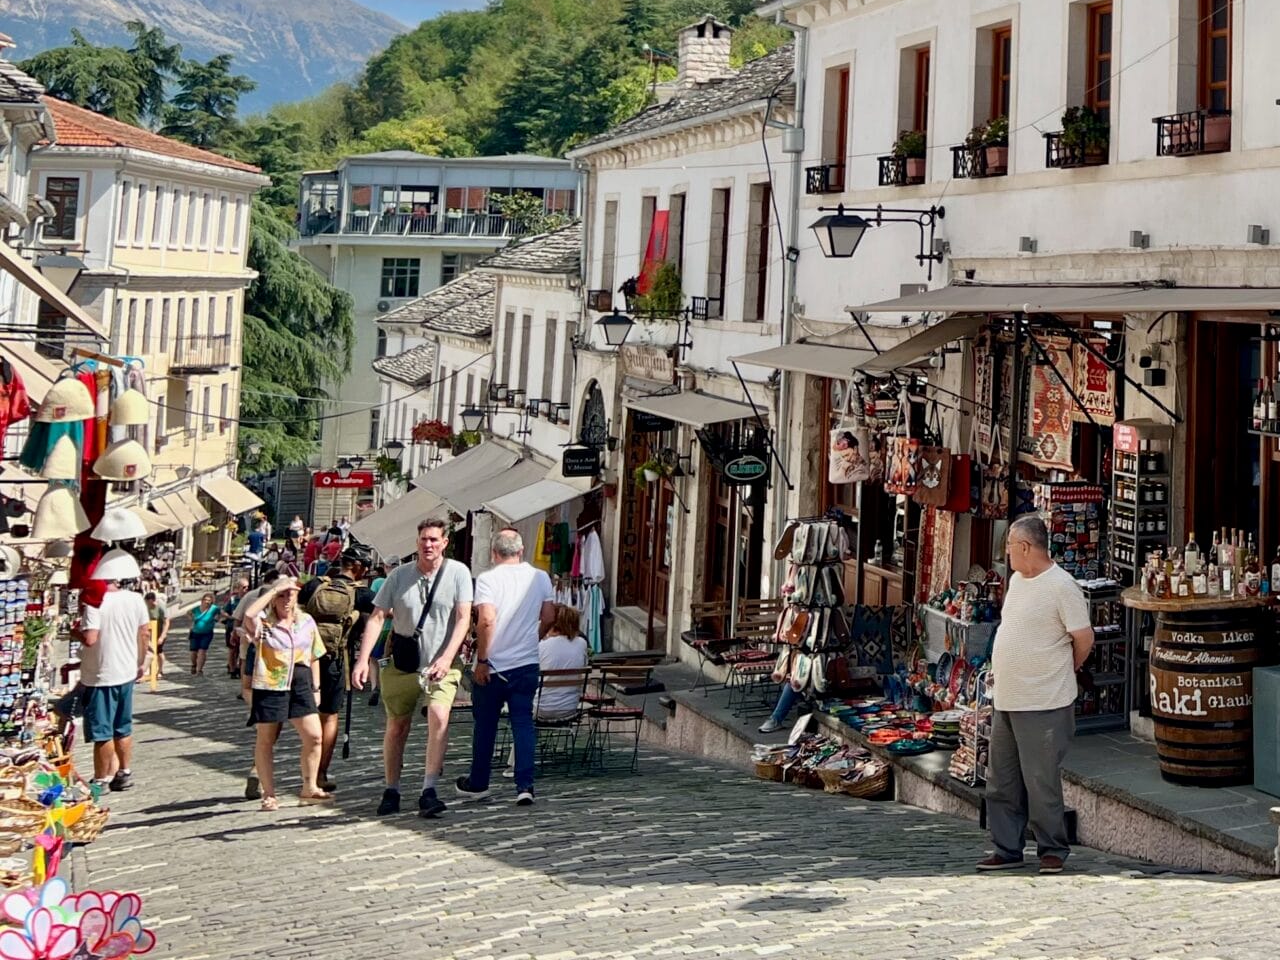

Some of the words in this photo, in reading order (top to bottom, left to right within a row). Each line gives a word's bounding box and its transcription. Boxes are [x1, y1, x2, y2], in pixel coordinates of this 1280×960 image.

[1171, 631, 1205, 644] Vodka
[1222, 632, 1255, 644] Liker
[1155, 646, 1193, 662] Traditional
[1190, 651, 1235, 665] Albanian
[1177, 676, 1244, 688] Botanikal
[1151, 672, 1208, 716] Raki
